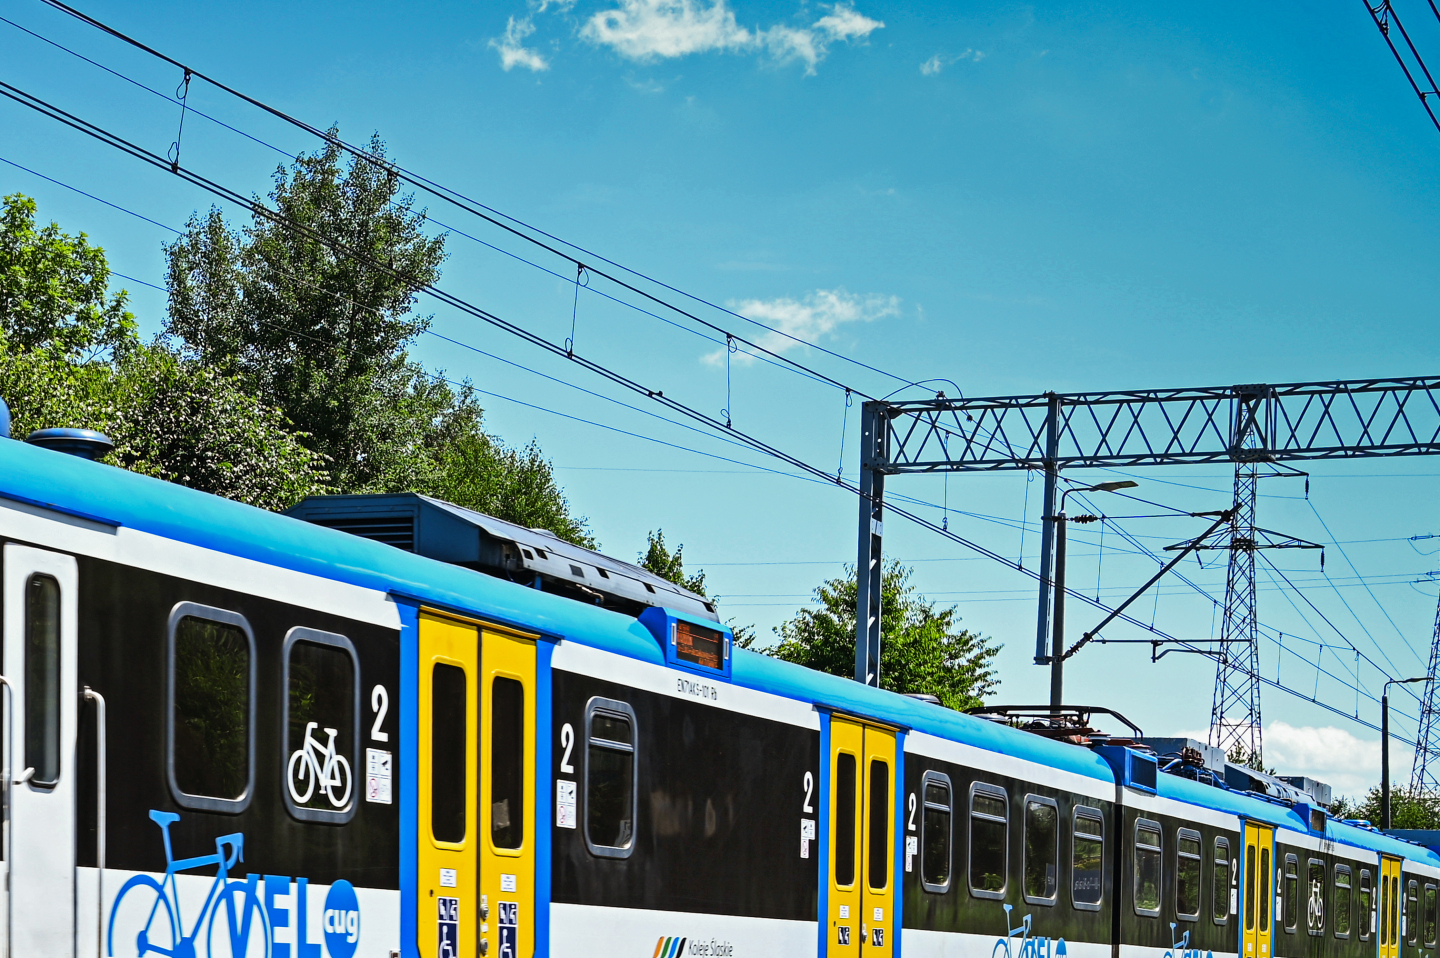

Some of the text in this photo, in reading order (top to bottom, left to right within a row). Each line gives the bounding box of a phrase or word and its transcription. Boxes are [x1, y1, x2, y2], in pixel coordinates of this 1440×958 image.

[371, 684, 389, 742] 2
[560, 723, 575, 774] 2
[803, 771, 814, 813] 2
[908, 792, 917, 831] 2
[1231, 858, 1238, 885] 2
[323, 908, 359, 944] cug
